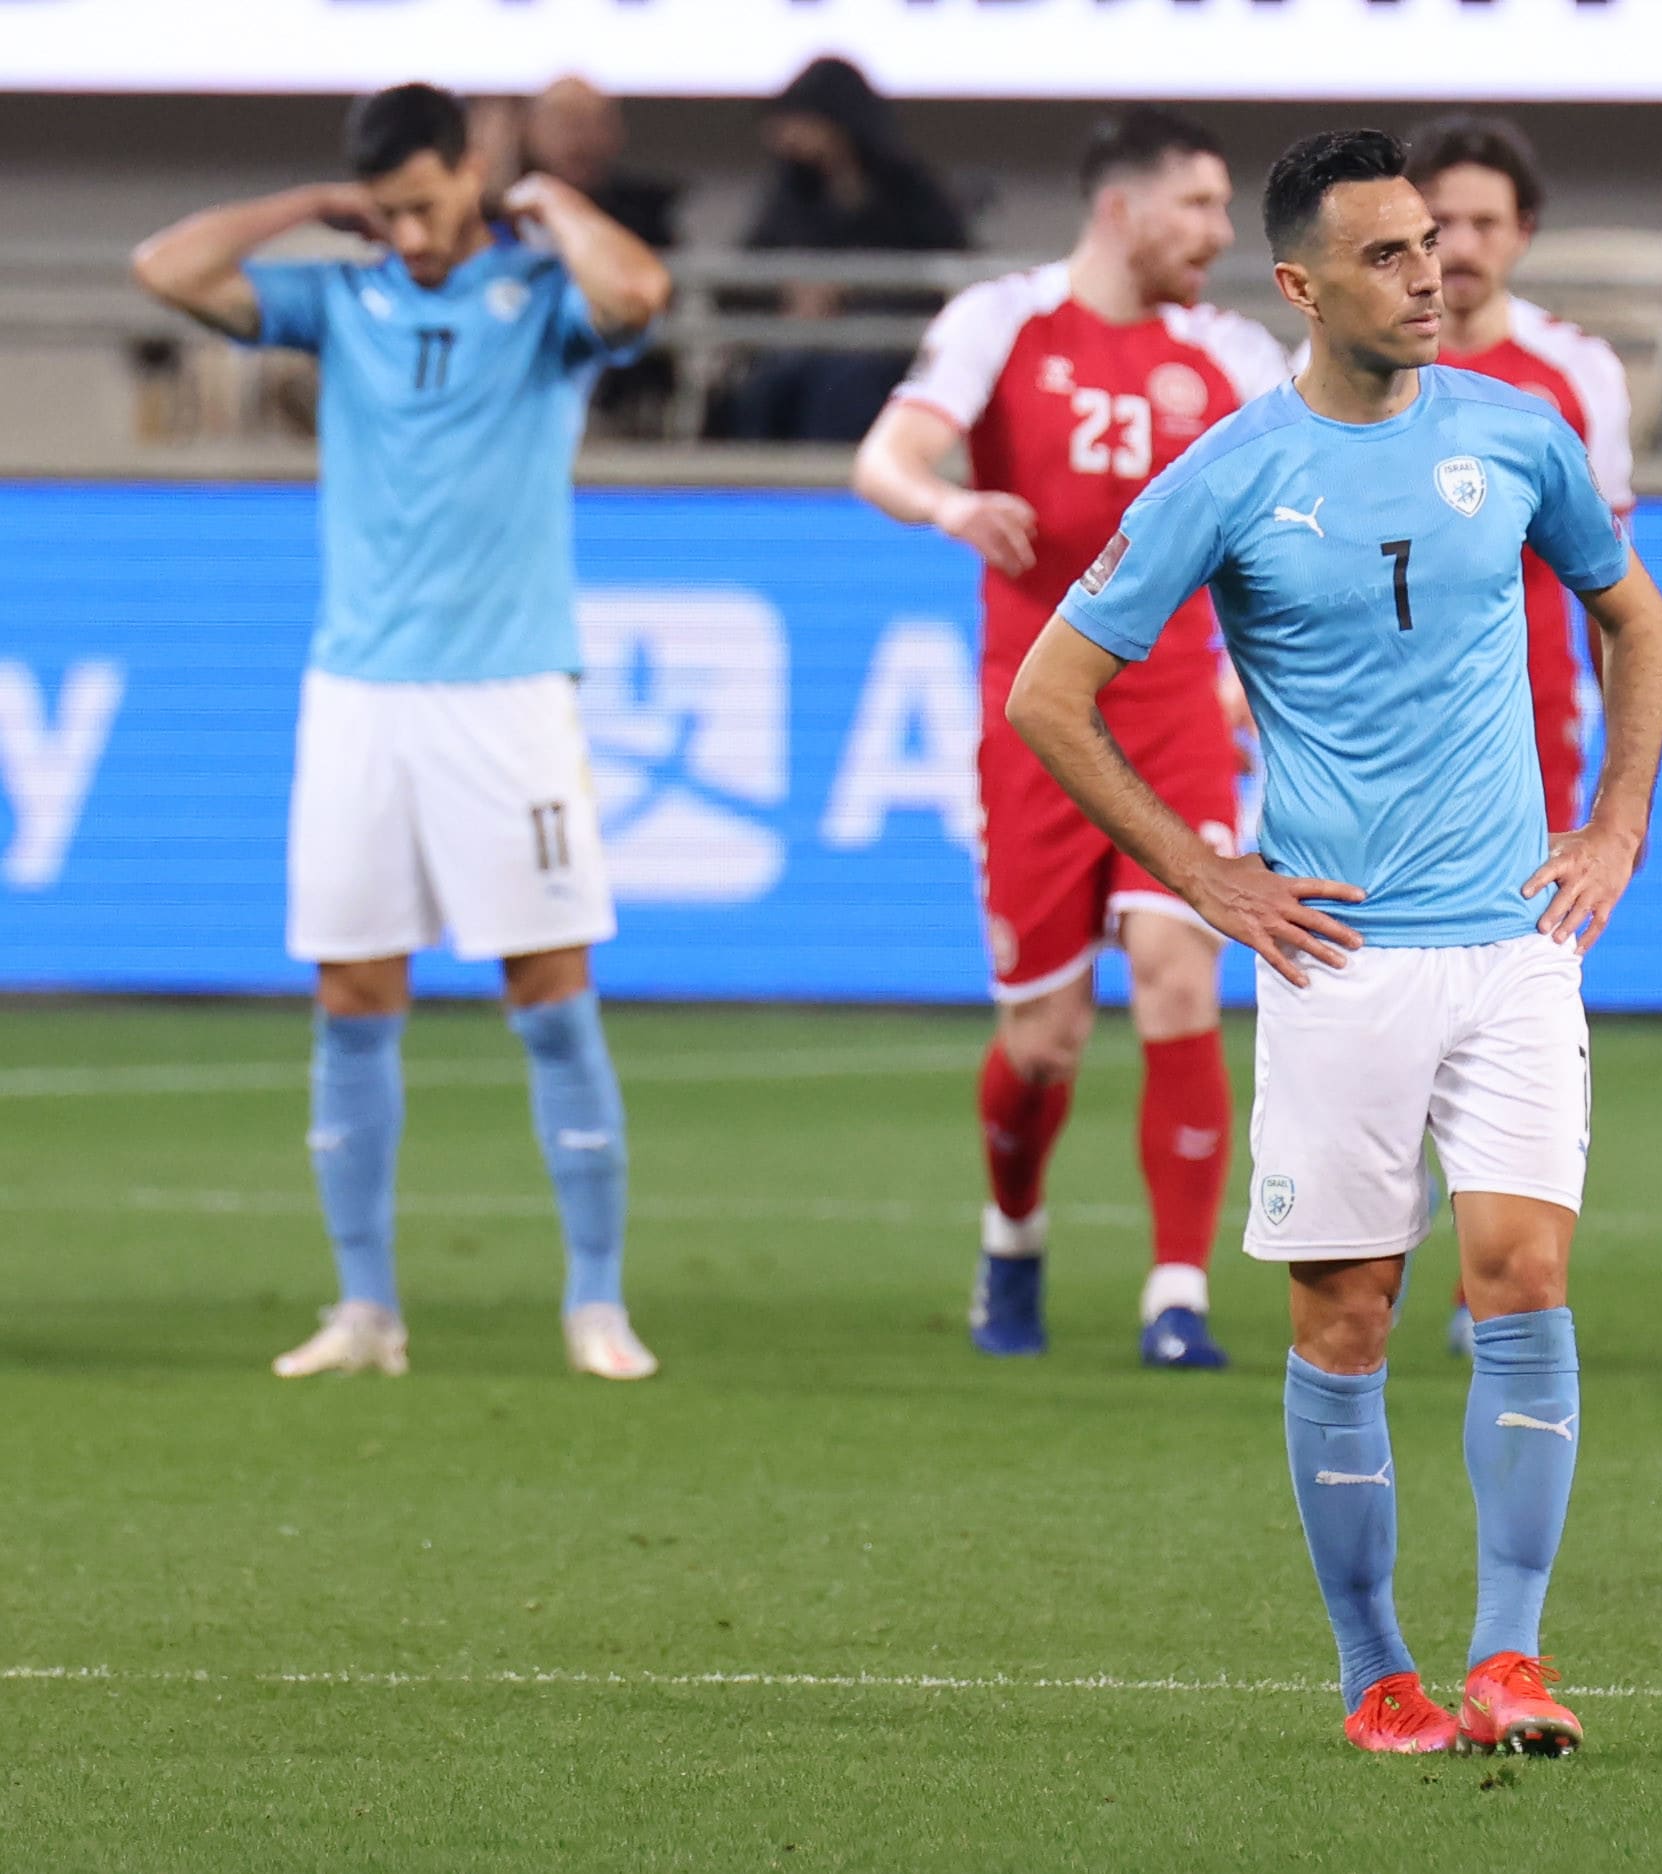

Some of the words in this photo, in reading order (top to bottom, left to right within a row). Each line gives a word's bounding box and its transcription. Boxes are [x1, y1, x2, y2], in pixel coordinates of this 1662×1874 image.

[1069, 386, 1152, 479] 23
[1444, 463, 1475, 474] ISRAEL
[1380, 539, 1413, 631] 7
